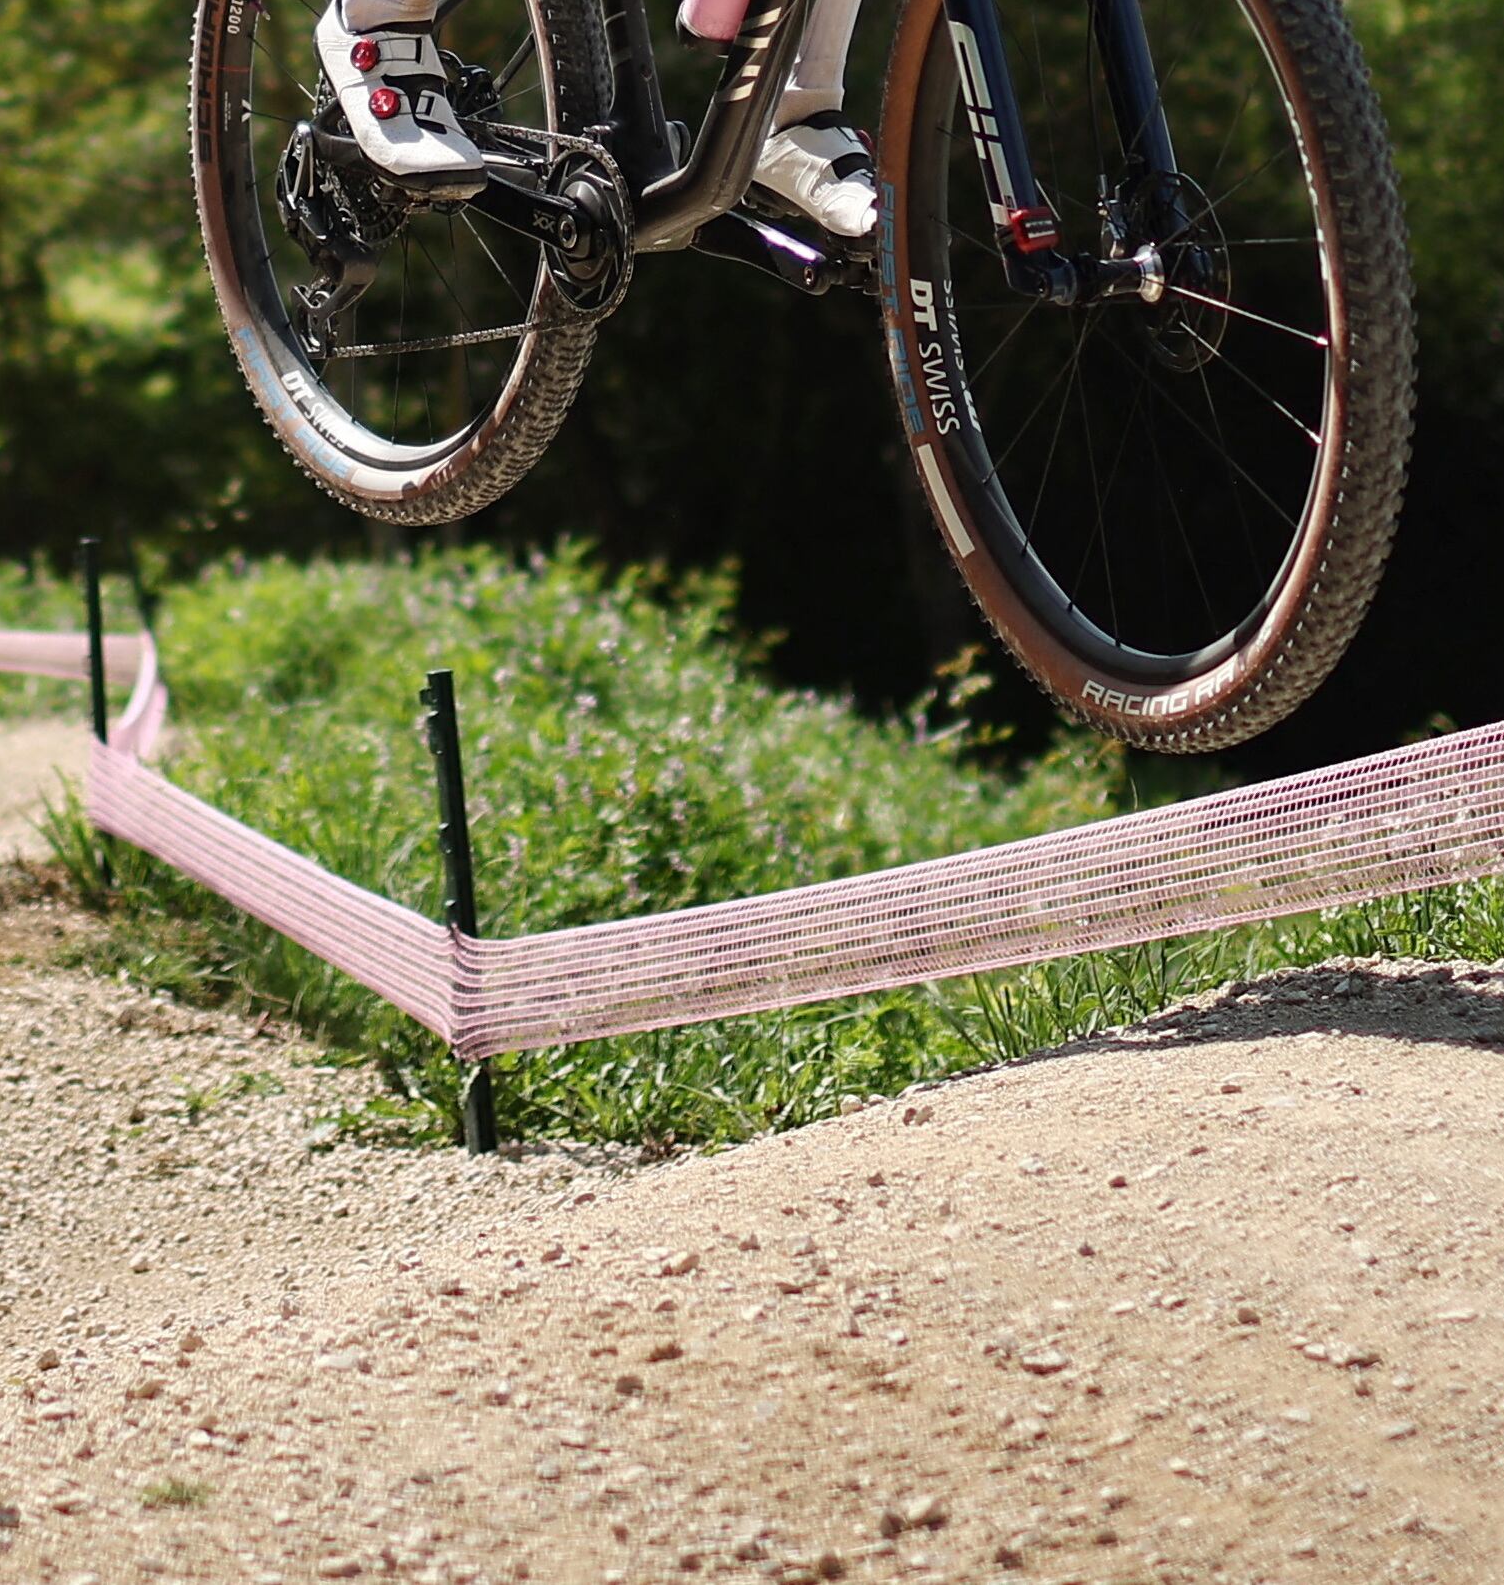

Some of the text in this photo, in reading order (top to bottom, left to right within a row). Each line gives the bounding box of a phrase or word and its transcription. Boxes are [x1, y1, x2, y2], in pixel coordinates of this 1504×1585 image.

[227, 0, 244, 34] 1200
[879, 181, 925, 435] FIRST RIDE
[909, 277, 961, 435] DT SWISS
[281, 369, 315, 403] DT
[1081, 679, 1190, 717] RACING
